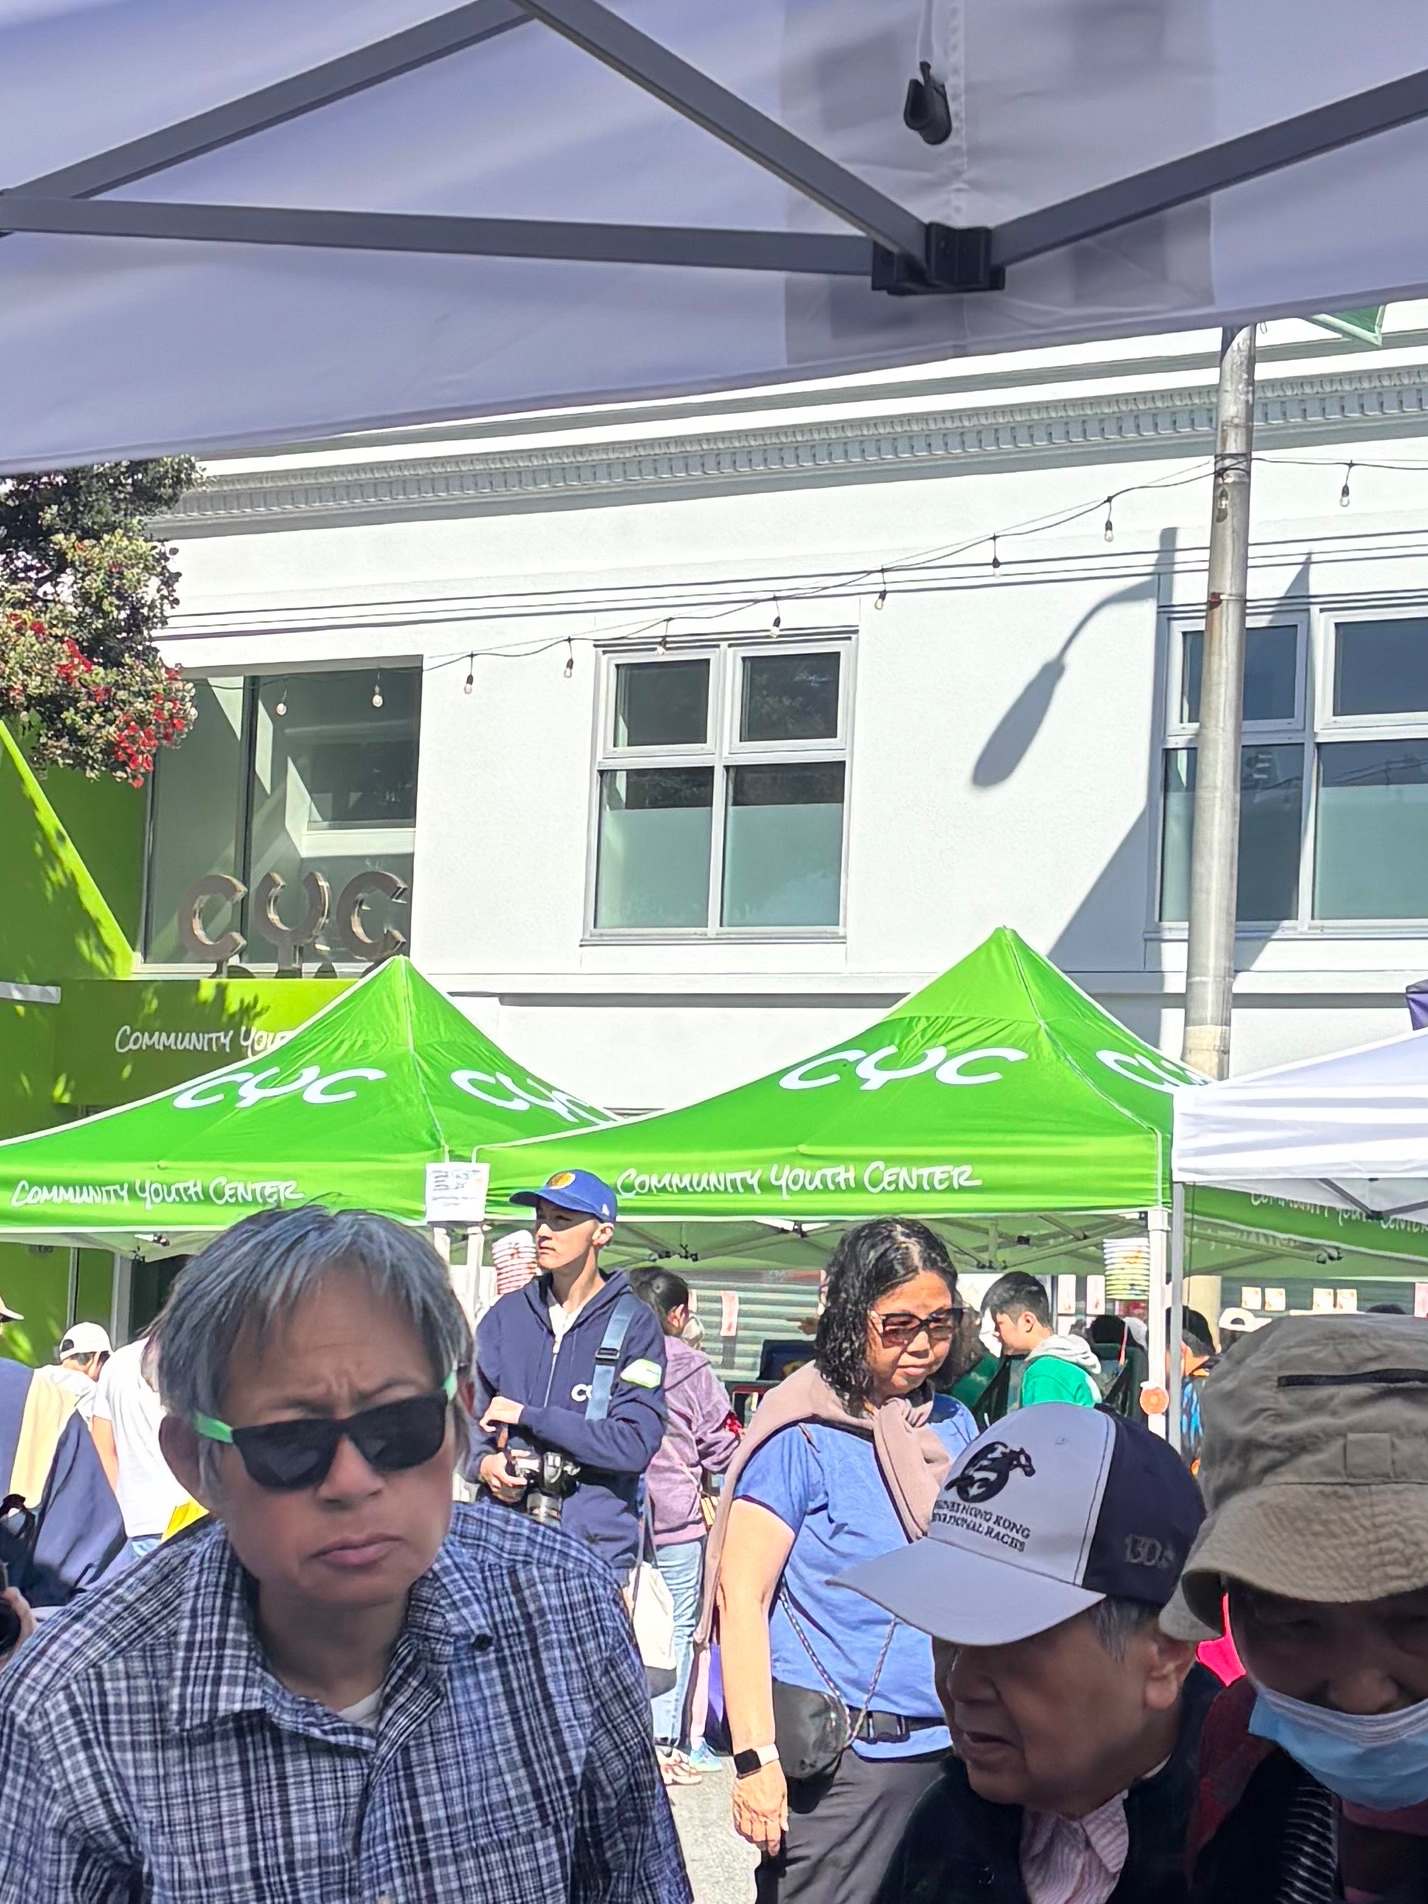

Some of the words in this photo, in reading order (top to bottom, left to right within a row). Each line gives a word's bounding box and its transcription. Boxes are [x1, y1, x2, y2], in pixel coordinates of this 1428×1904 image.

[177, 870, 409, 966] CYC
[114, 1024, 233, 1054] COMMUNITY
[173, 1065, 387, 1110] CYC
[778, 1043, 1029, 1092] CYC
[11, 1179, 132, 1208] COMMUNITY
[134, 1179, 202, 1212] YOUTH
[207, 1175, 305, 1205] CENTER
[616, 1167, 763, 1200] COMMUNITY
[770, 1164, 855, 1202] YOUTH
[863, 1160, 982, 1195] CENTER
[993, 1515, 1031, 1540] KONG
